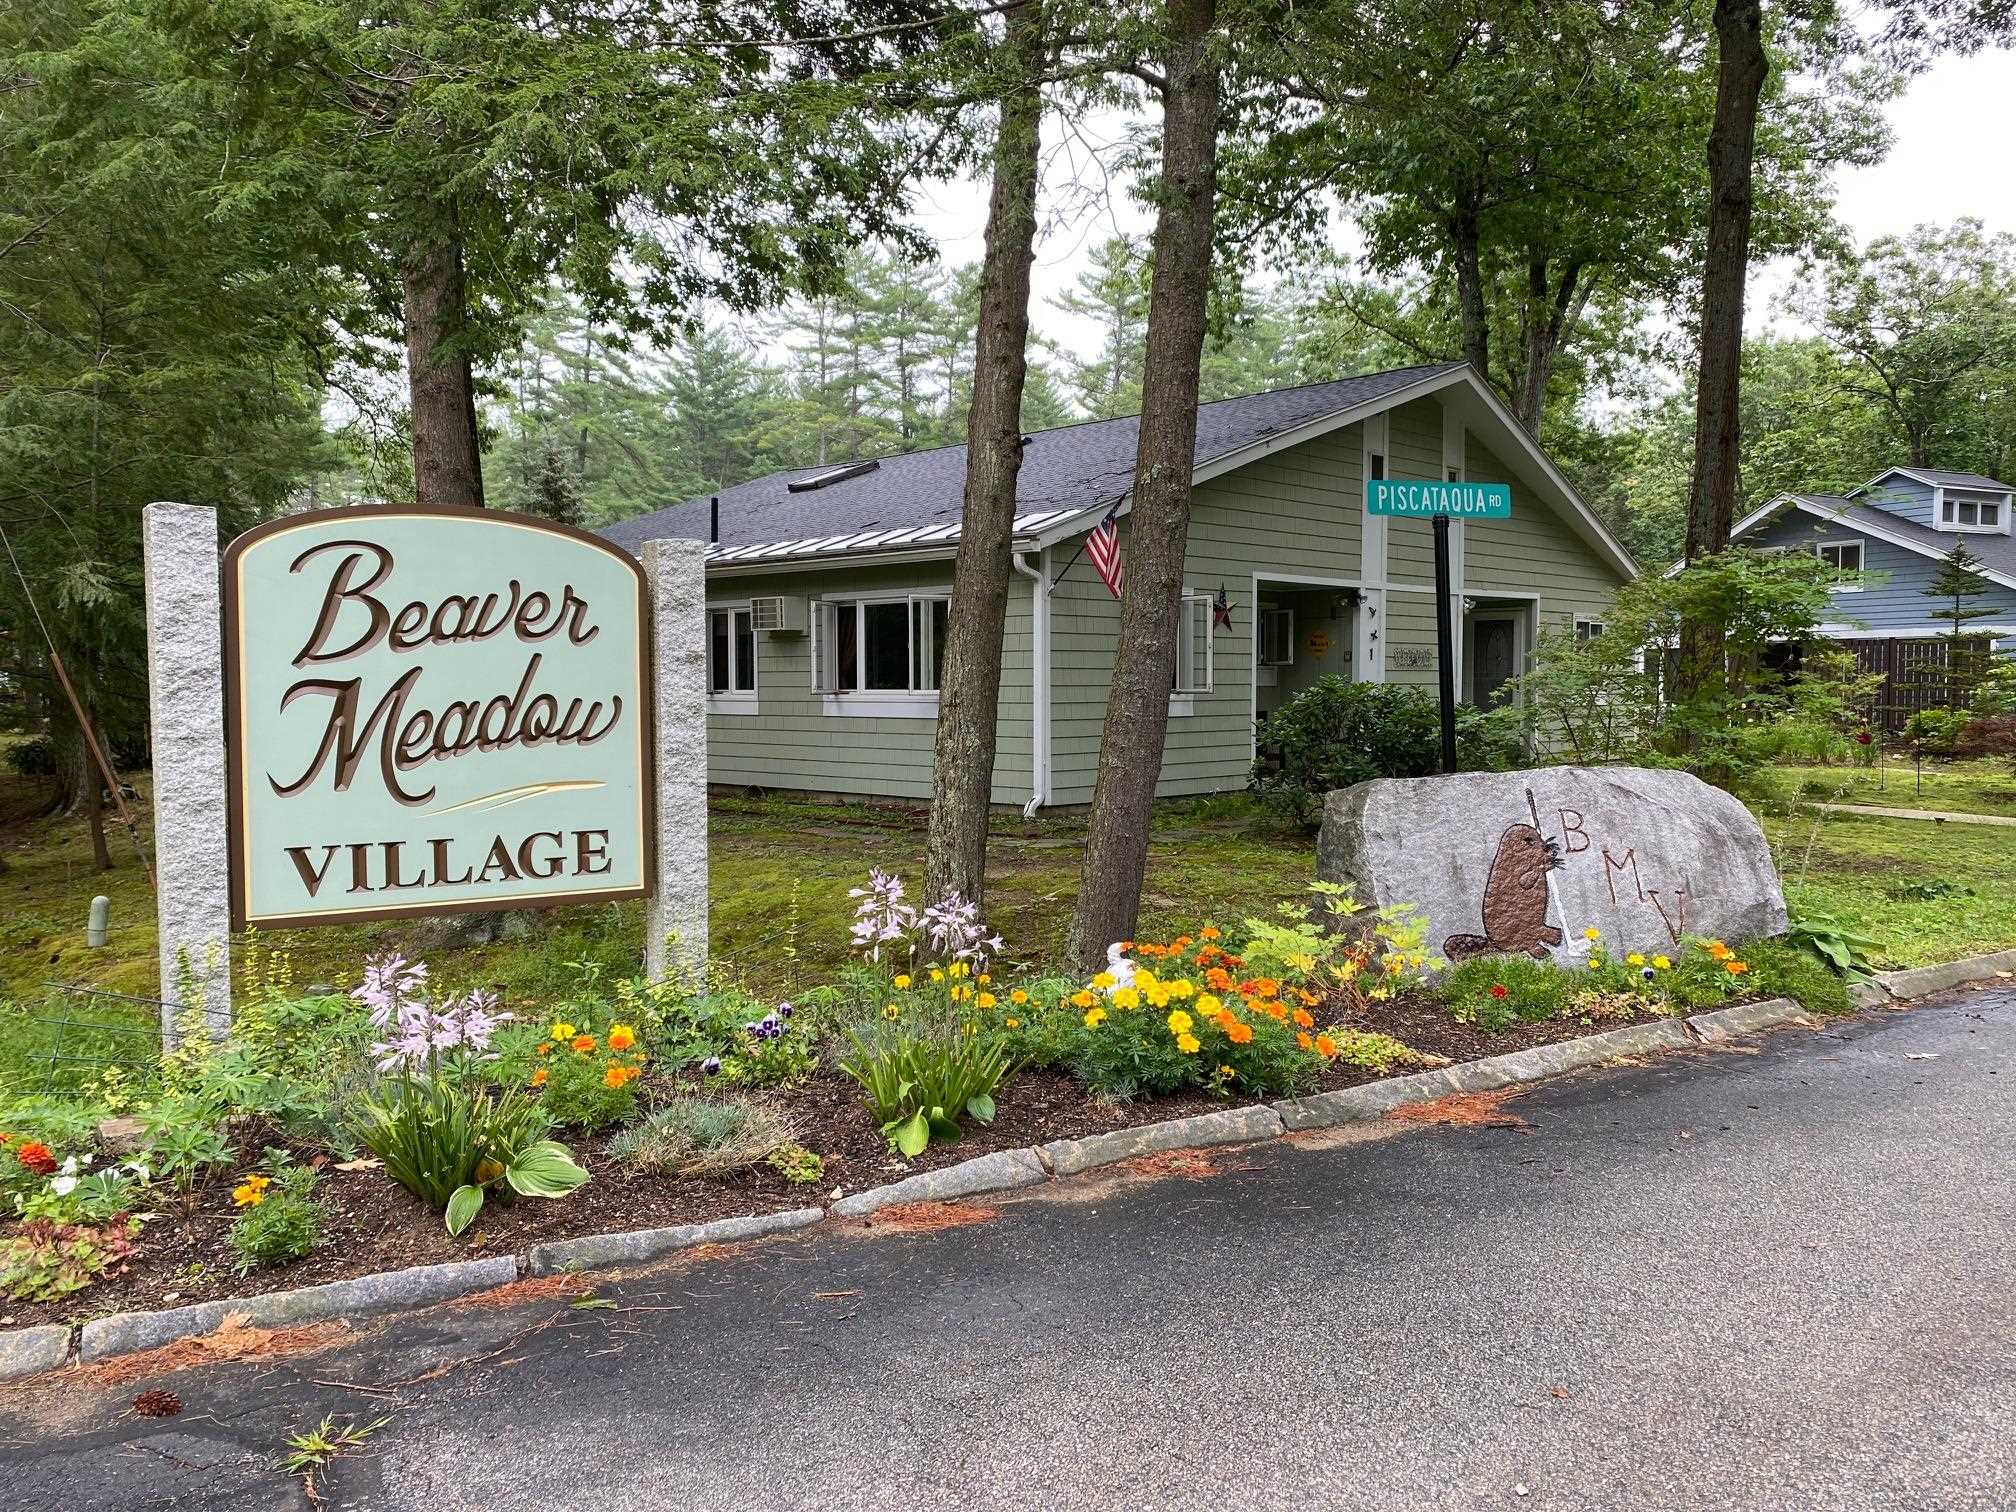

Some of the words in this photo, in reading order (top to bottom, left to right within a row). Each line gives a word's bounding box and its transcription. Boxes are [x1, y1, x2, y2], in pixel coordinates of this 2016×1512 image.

[1378, 485, 1486, 512] PISCATAQUA
[1489, 494, 1502, 507] RD
[289, 540, 600, 670] Beaver
[266, 653, 623, 807] Meadow
[284, 829, 613, 898] VILLAGE
